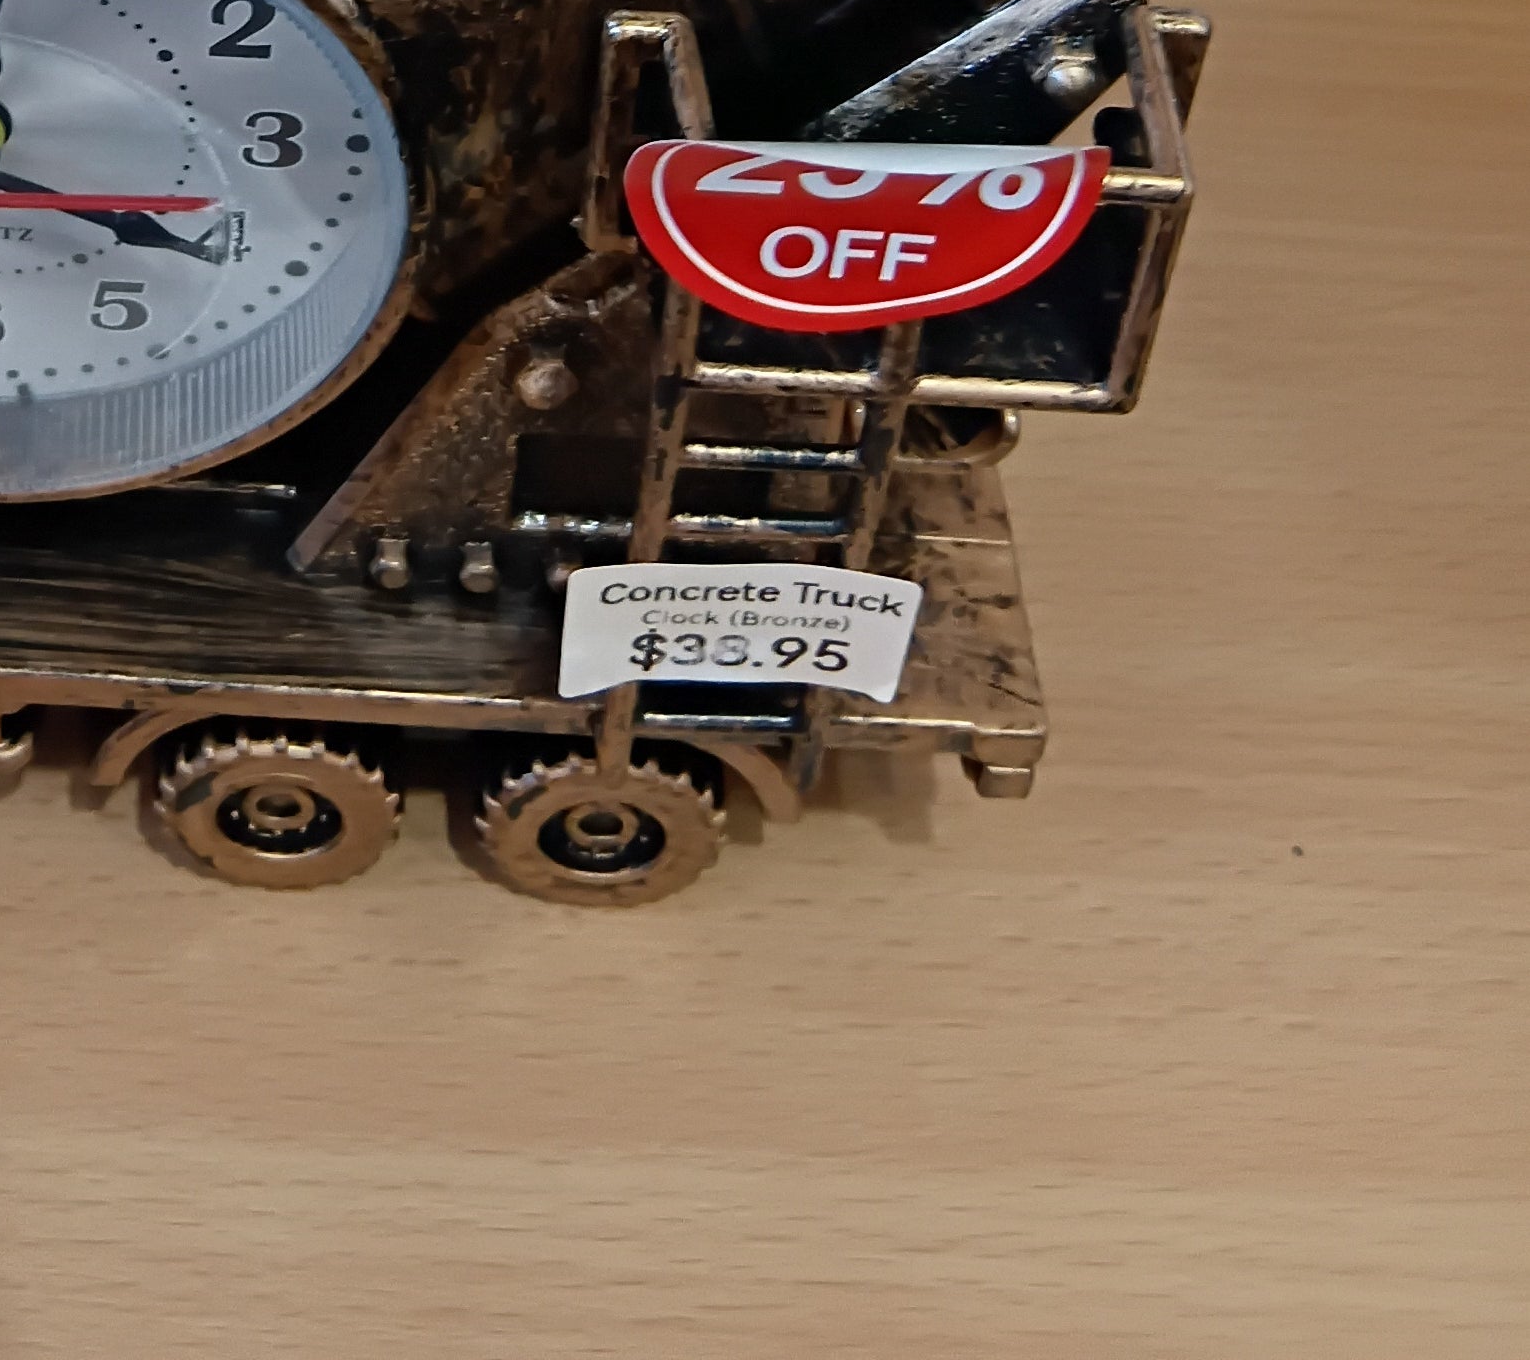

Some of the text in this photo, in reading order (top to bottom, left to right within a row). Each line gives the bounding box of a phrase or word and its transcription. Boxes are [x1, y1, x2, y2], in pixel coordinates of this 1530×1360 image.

[243, 111, 305, 169] 3
[759, 225, 937, 281] OFF
[90, 281, 150, 331] 5
[600, 581, 904, 617] Concrete Truck
[641, 610, 852, 632] Clock (Bronze)
